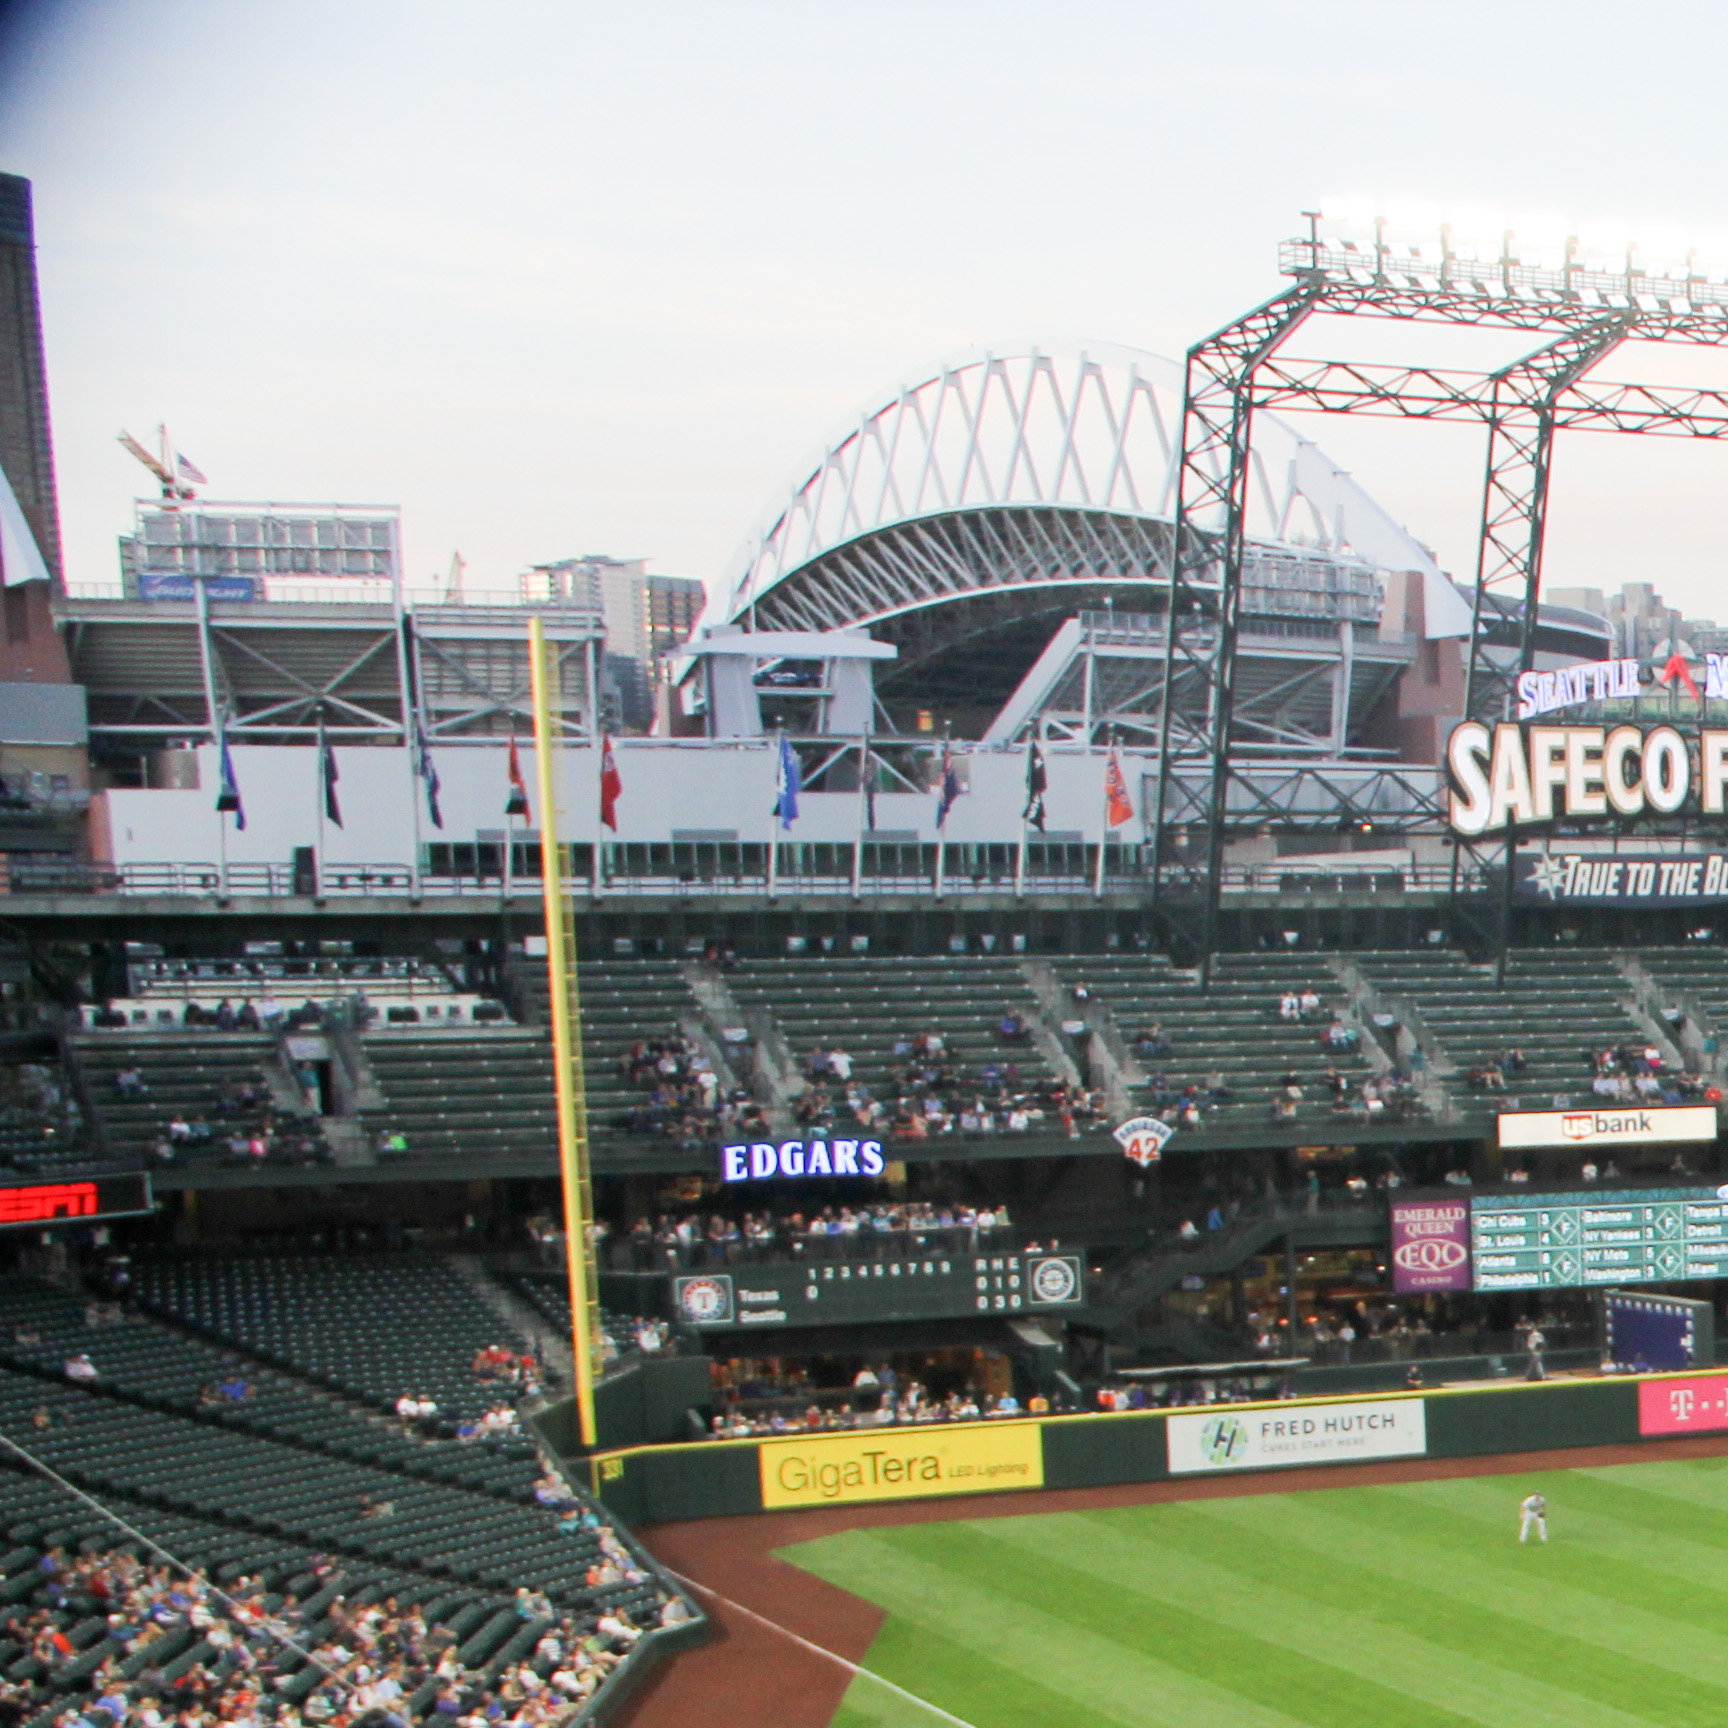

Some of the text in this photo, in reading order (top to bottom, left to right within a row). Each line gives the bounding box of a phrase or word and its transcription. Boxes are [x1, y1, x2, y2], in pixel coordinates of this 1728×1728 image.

[1518, 658, 1641, 720] SEATTLE
[1448, 721, 1690, 836] SAFECO
[1562, 855, 1619, 897] TRUE
[1625, 861, 1656, 897] TO
[1658, 861, 1702, 896] THE
[723, 1139, 886, 1182] EDGAR'S
[1128, 1137, 1160, 1160] 42
[1394, 1207, 1466, 1222] EMERALD
[1404, 1221, 1456, 1236] QUEEN
[738, 1288, 780, 1303] Texas
[738, 1309, 787, 1324] Seattle
[1261, 1413, 1396, 1438] FRED HUTCH
[778, 1450, 942, 1498] GigaTera
